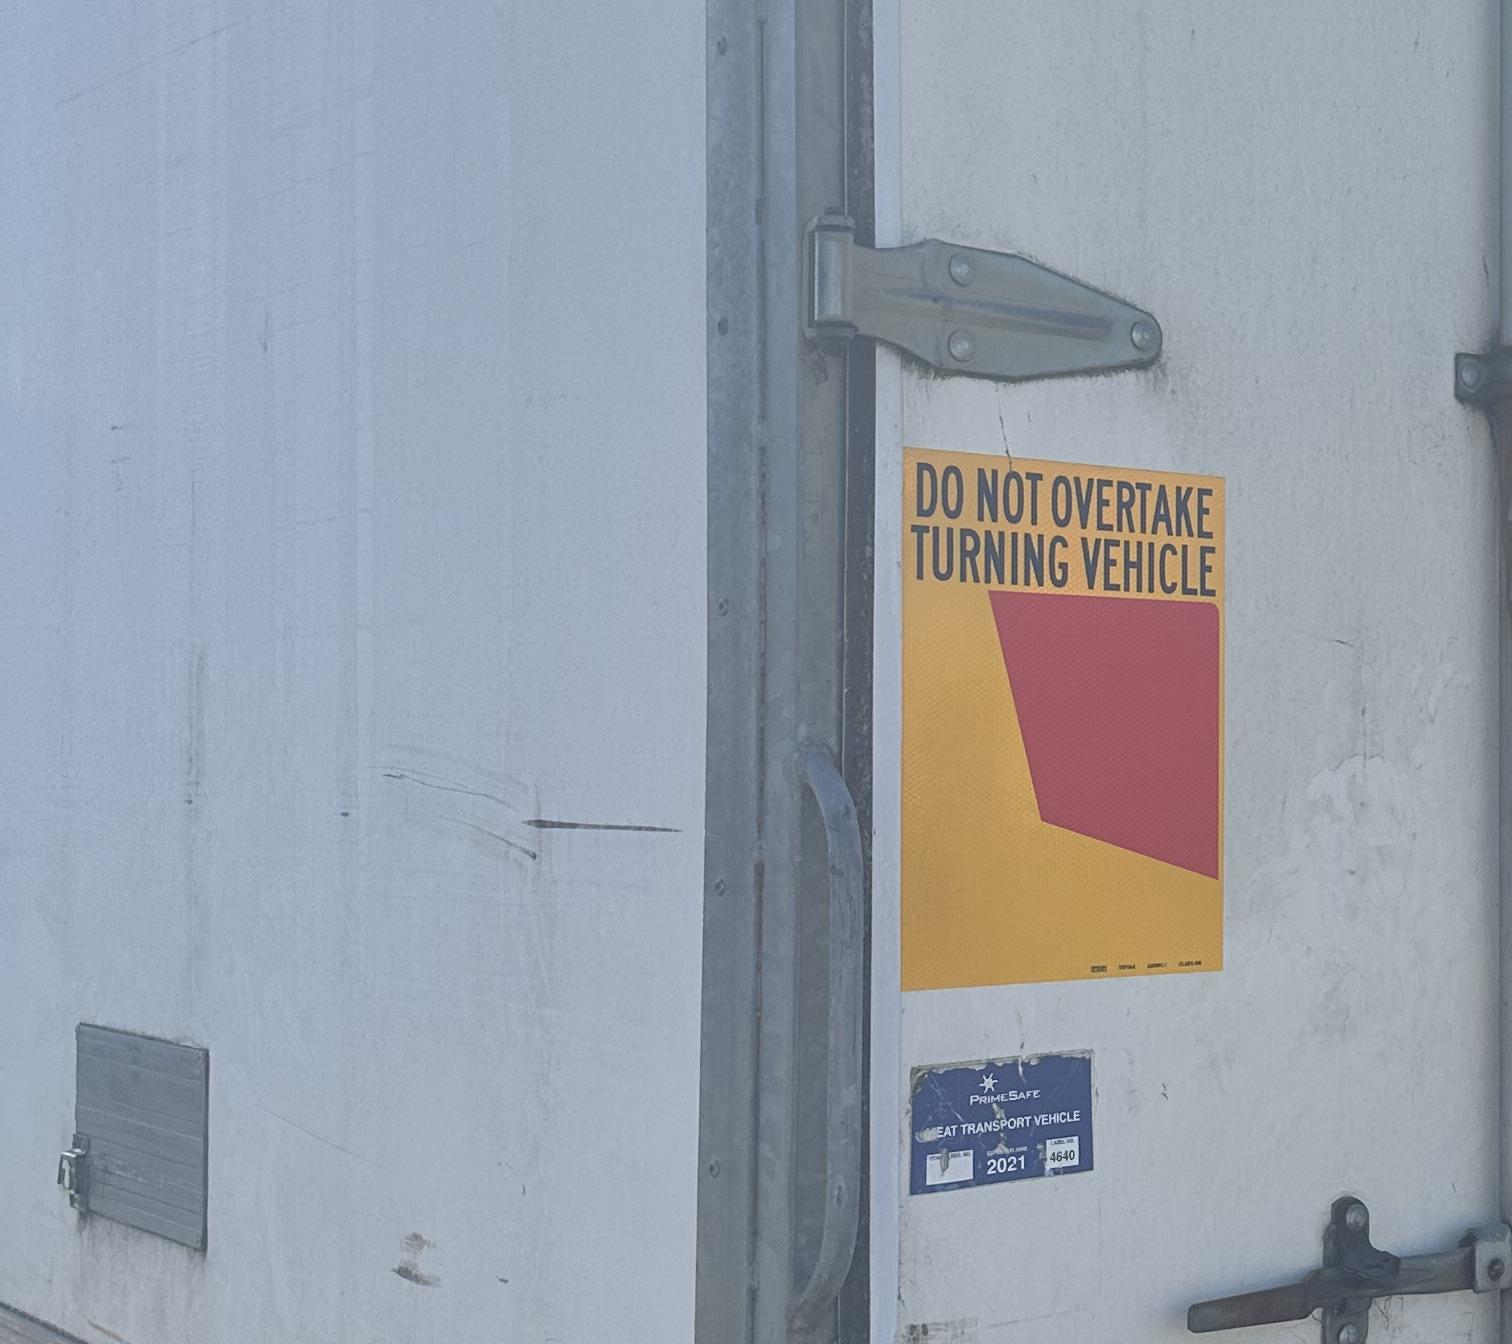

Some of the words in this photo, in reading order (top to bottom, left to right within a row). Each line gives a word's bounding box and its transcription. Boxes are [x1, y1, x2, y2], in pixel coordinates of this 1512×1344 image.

[916, 461, 964, 520] DO
[976, 467, 1044, 526] NOT
[1050, 474, 1214, 540] OVERTAKE
[910, 524, 1069, 589] TURNING
[1080, 536, 1217, 598] VEHICLE
[926, 1124, 959, 1141] EAT
[960, 1116, 1033, 1136] TRANSPORT
[1033, 1109, 1081, 1127] VEHICLE
[986, 1154, 1026, 1175] 2021
[1049, 1149, 1076, 1163] 4640
